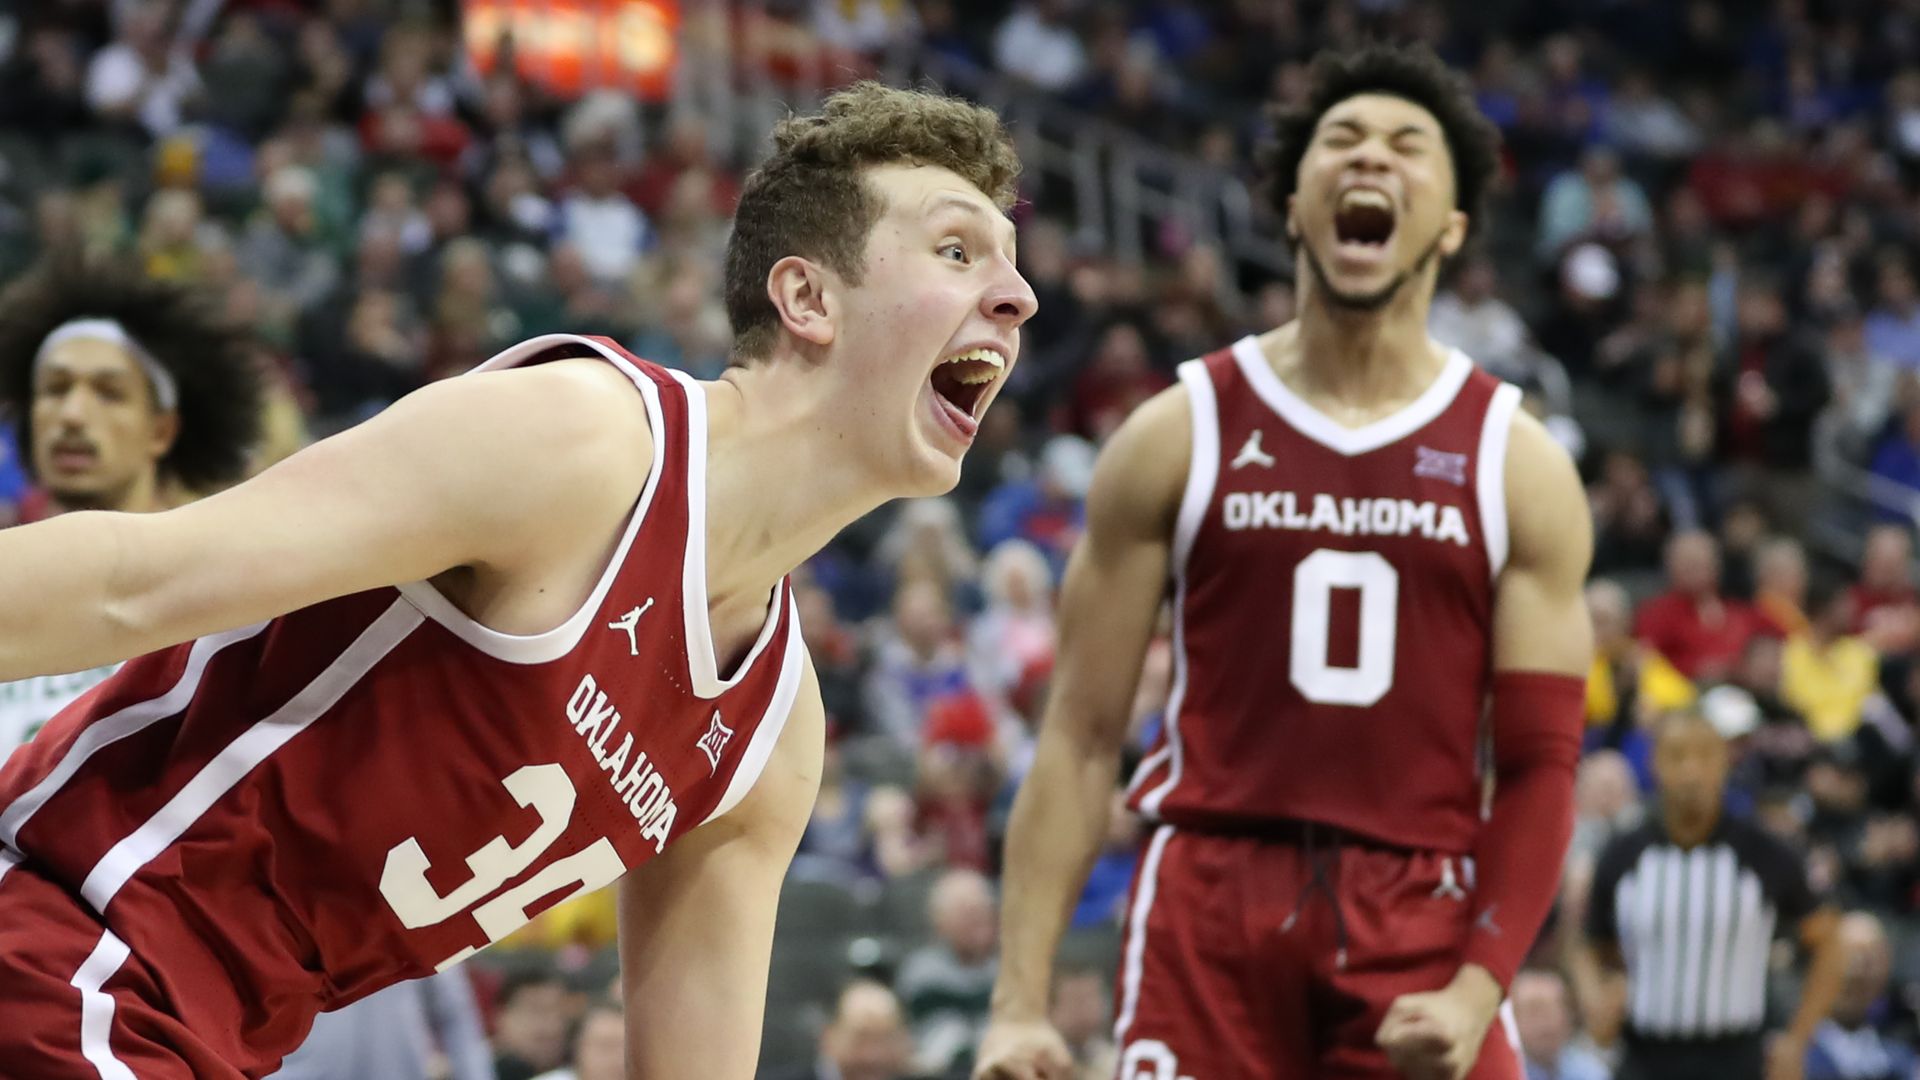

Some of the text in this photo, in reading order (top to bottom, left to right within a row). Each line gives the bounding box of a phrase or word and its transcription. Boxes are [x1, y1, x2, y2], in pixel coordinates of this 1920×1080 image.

[1223, 491, 1469, 546] OKLAHOMA
[1289, 548, 1399, 708] 0
[566, 673, 678, 855] OKLAHOMA
